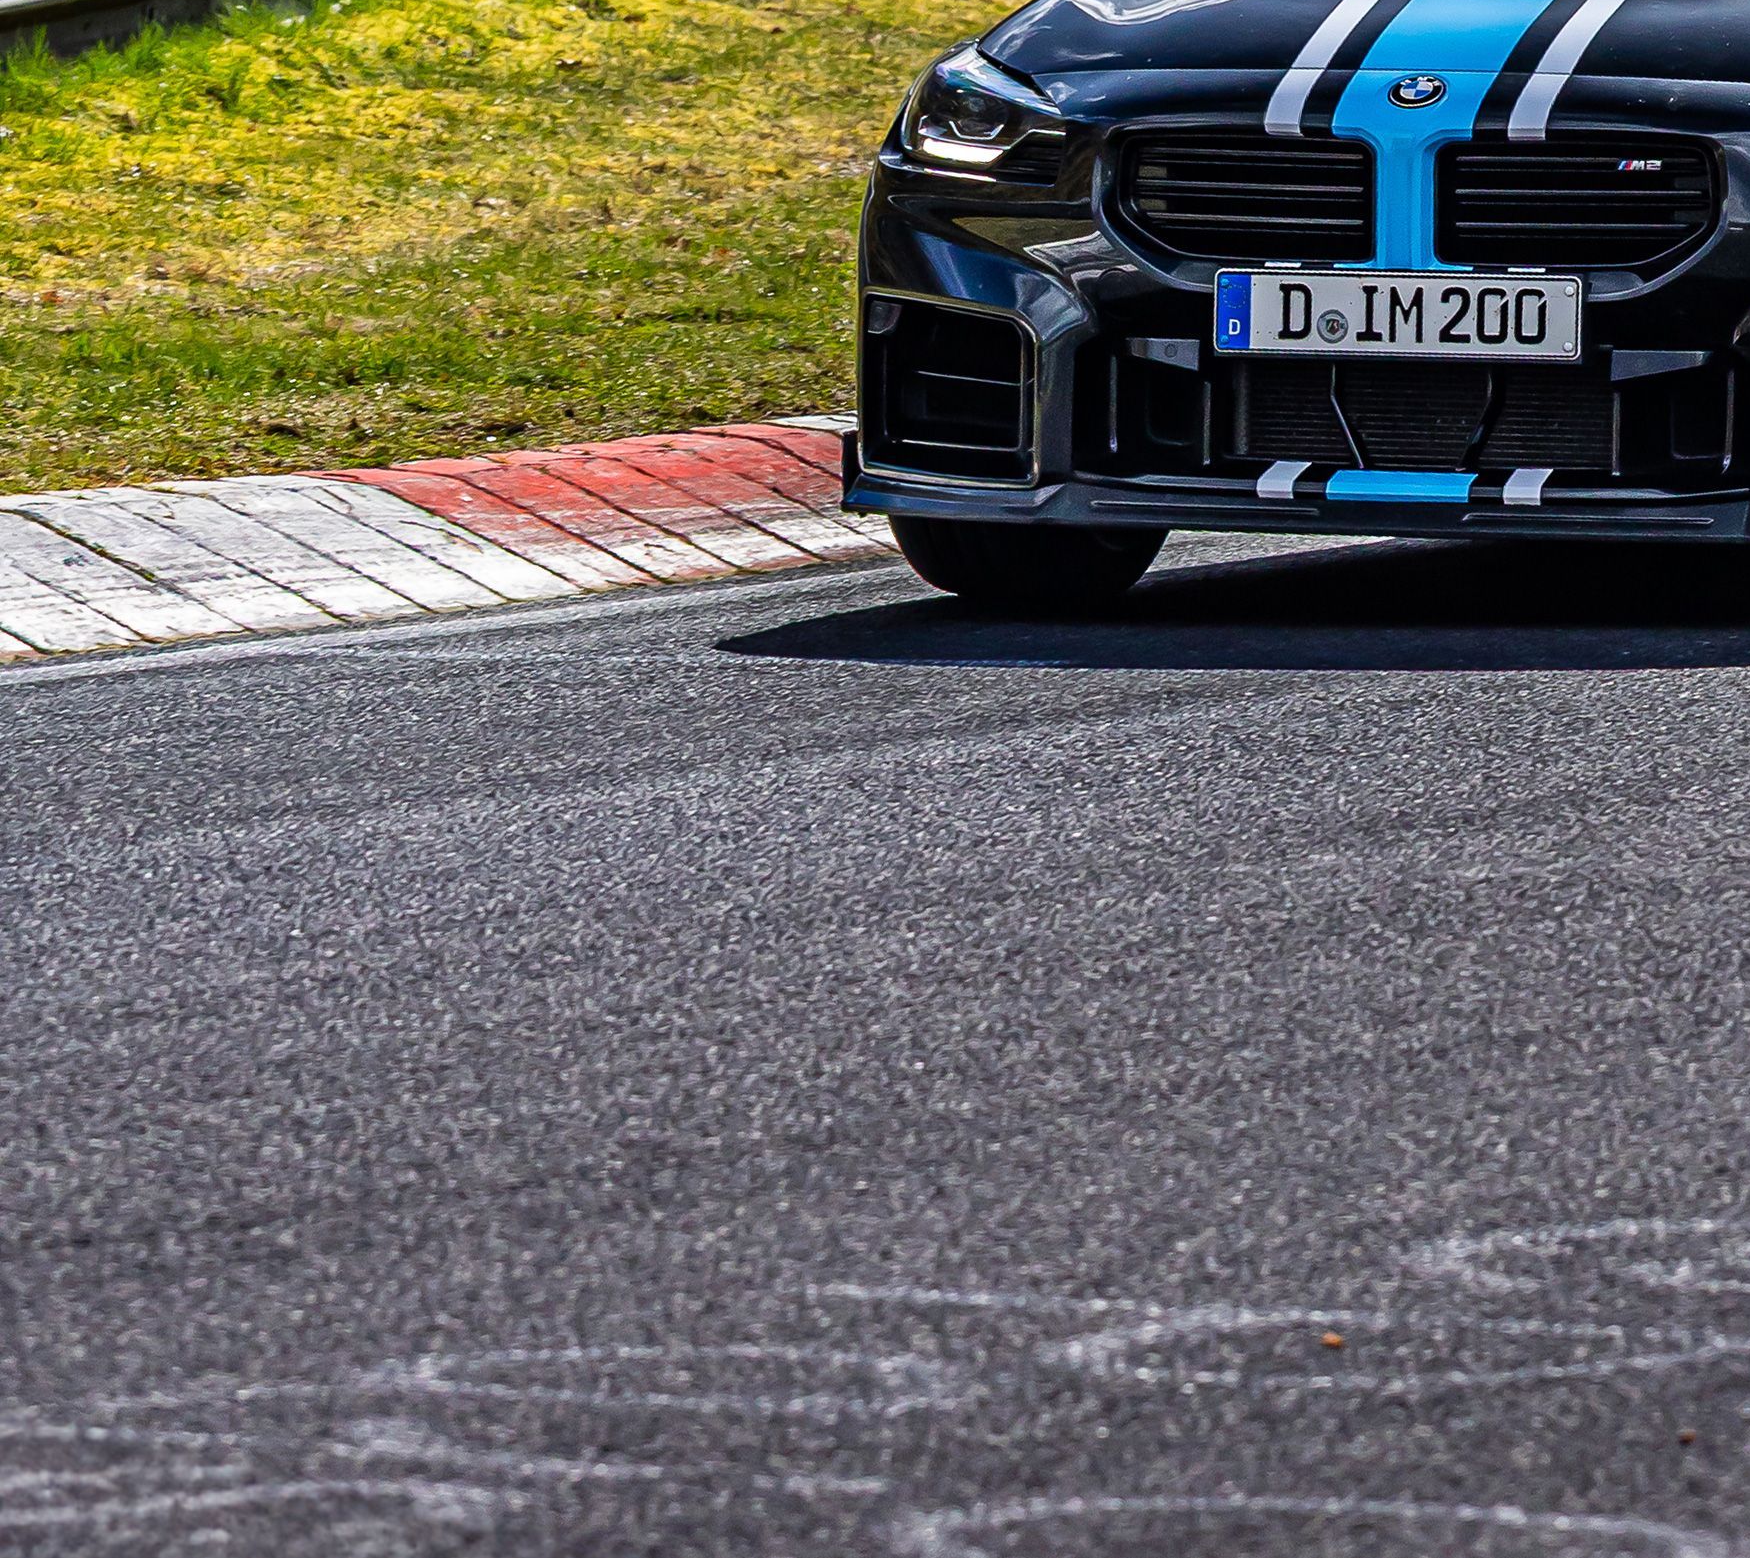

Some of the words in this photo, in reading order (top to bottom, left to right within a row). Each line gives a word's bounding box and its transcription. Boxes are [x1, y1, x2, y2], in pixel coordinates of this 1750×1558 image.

[1228, 319, 1241, 336] D
[1278, 283, 1313, 341] D
[1356, 285, 1424, 344] IM
[1439, 287, 1548, 345] 200
